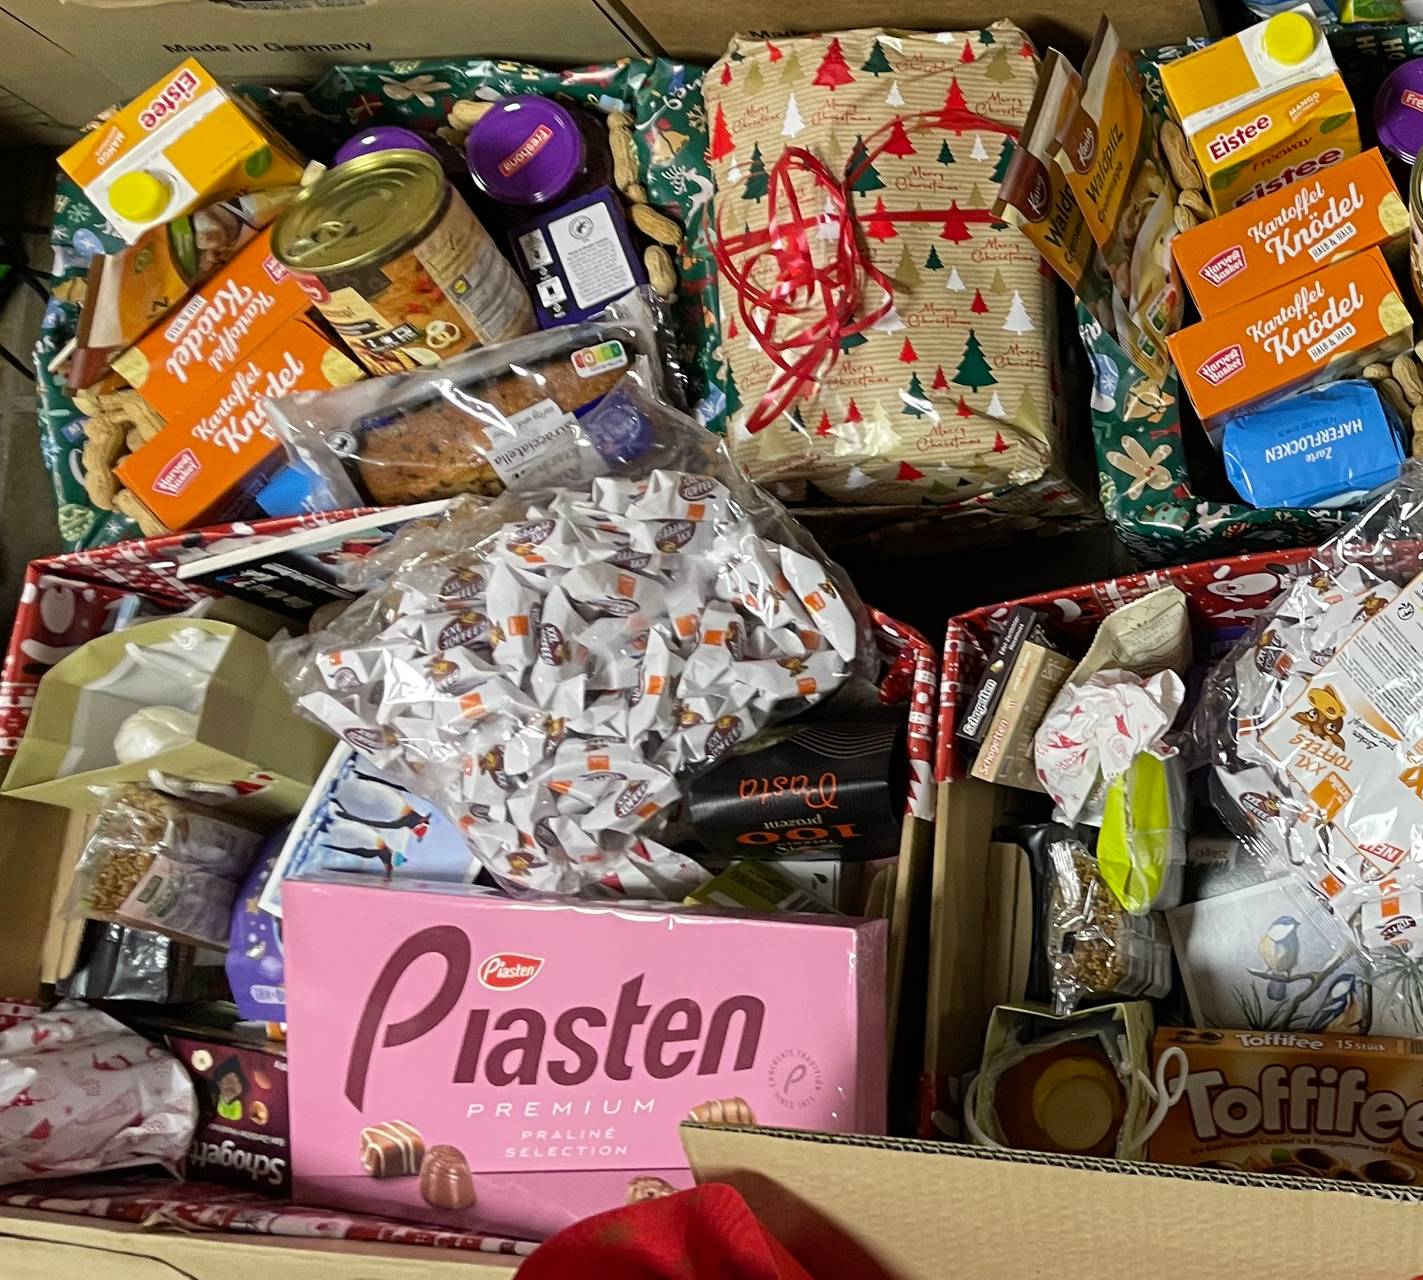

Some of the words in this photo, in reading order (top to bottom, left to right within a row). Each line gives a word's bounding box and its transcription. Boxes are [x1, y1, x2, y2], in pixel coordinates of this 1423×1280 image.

[162, 42, 229, 54] Made
[234, 43, 259, 52] In
[263, 41, 373, 53] Germany
[140, 71, 198, 128] Eistee
[1288, 92, 1321, 116] MANGO
[501, 127, 549, 174] Freshona
[1209, 116, 1270, 160] Eistee
[1085, 124, 1124, 203] Waldpilz
[1045, 184, 1074, 248] Waldp
[1247, 182, 1325, 243] Kartoffel
[1265, 182, 1364, 264] Knödel
[166, 279, 251, 383] Knödel
[208, 290, 275, 372] Kartoffel
[1246, 280, 1324, 343] Kartoffel
[1264, 281, 1364, 364] Knödel
[191, 362, 262, 442] Kartoffel
[1265, 418, 1363, 463] HAFERFLOCKEN
[1305, 447, 1333, 463] Zarte
[963, 679, 997, 737] Schogetten
[979, 720, 1009, 775] Schogetten
[1288, 733, 1355, 772] TOFFEES
[1297, 754, 1328, 776] XXL
[738, 772, 839, 809] Pasta
[735, 823, 863, 845] 100
[483, 955, 537, 979] Piasten
[344, 924, 766, 1113] Piasten
[1234, 1033, 1324, 1049] Toffifee
[1336, 1039, 1353, 1050] 15
[466, 1099, 658, 1119] PREMIUM
[505, 1143, 628, 1158] SELECTION
[520, 1128, 615, 1141] PRALINÉ
